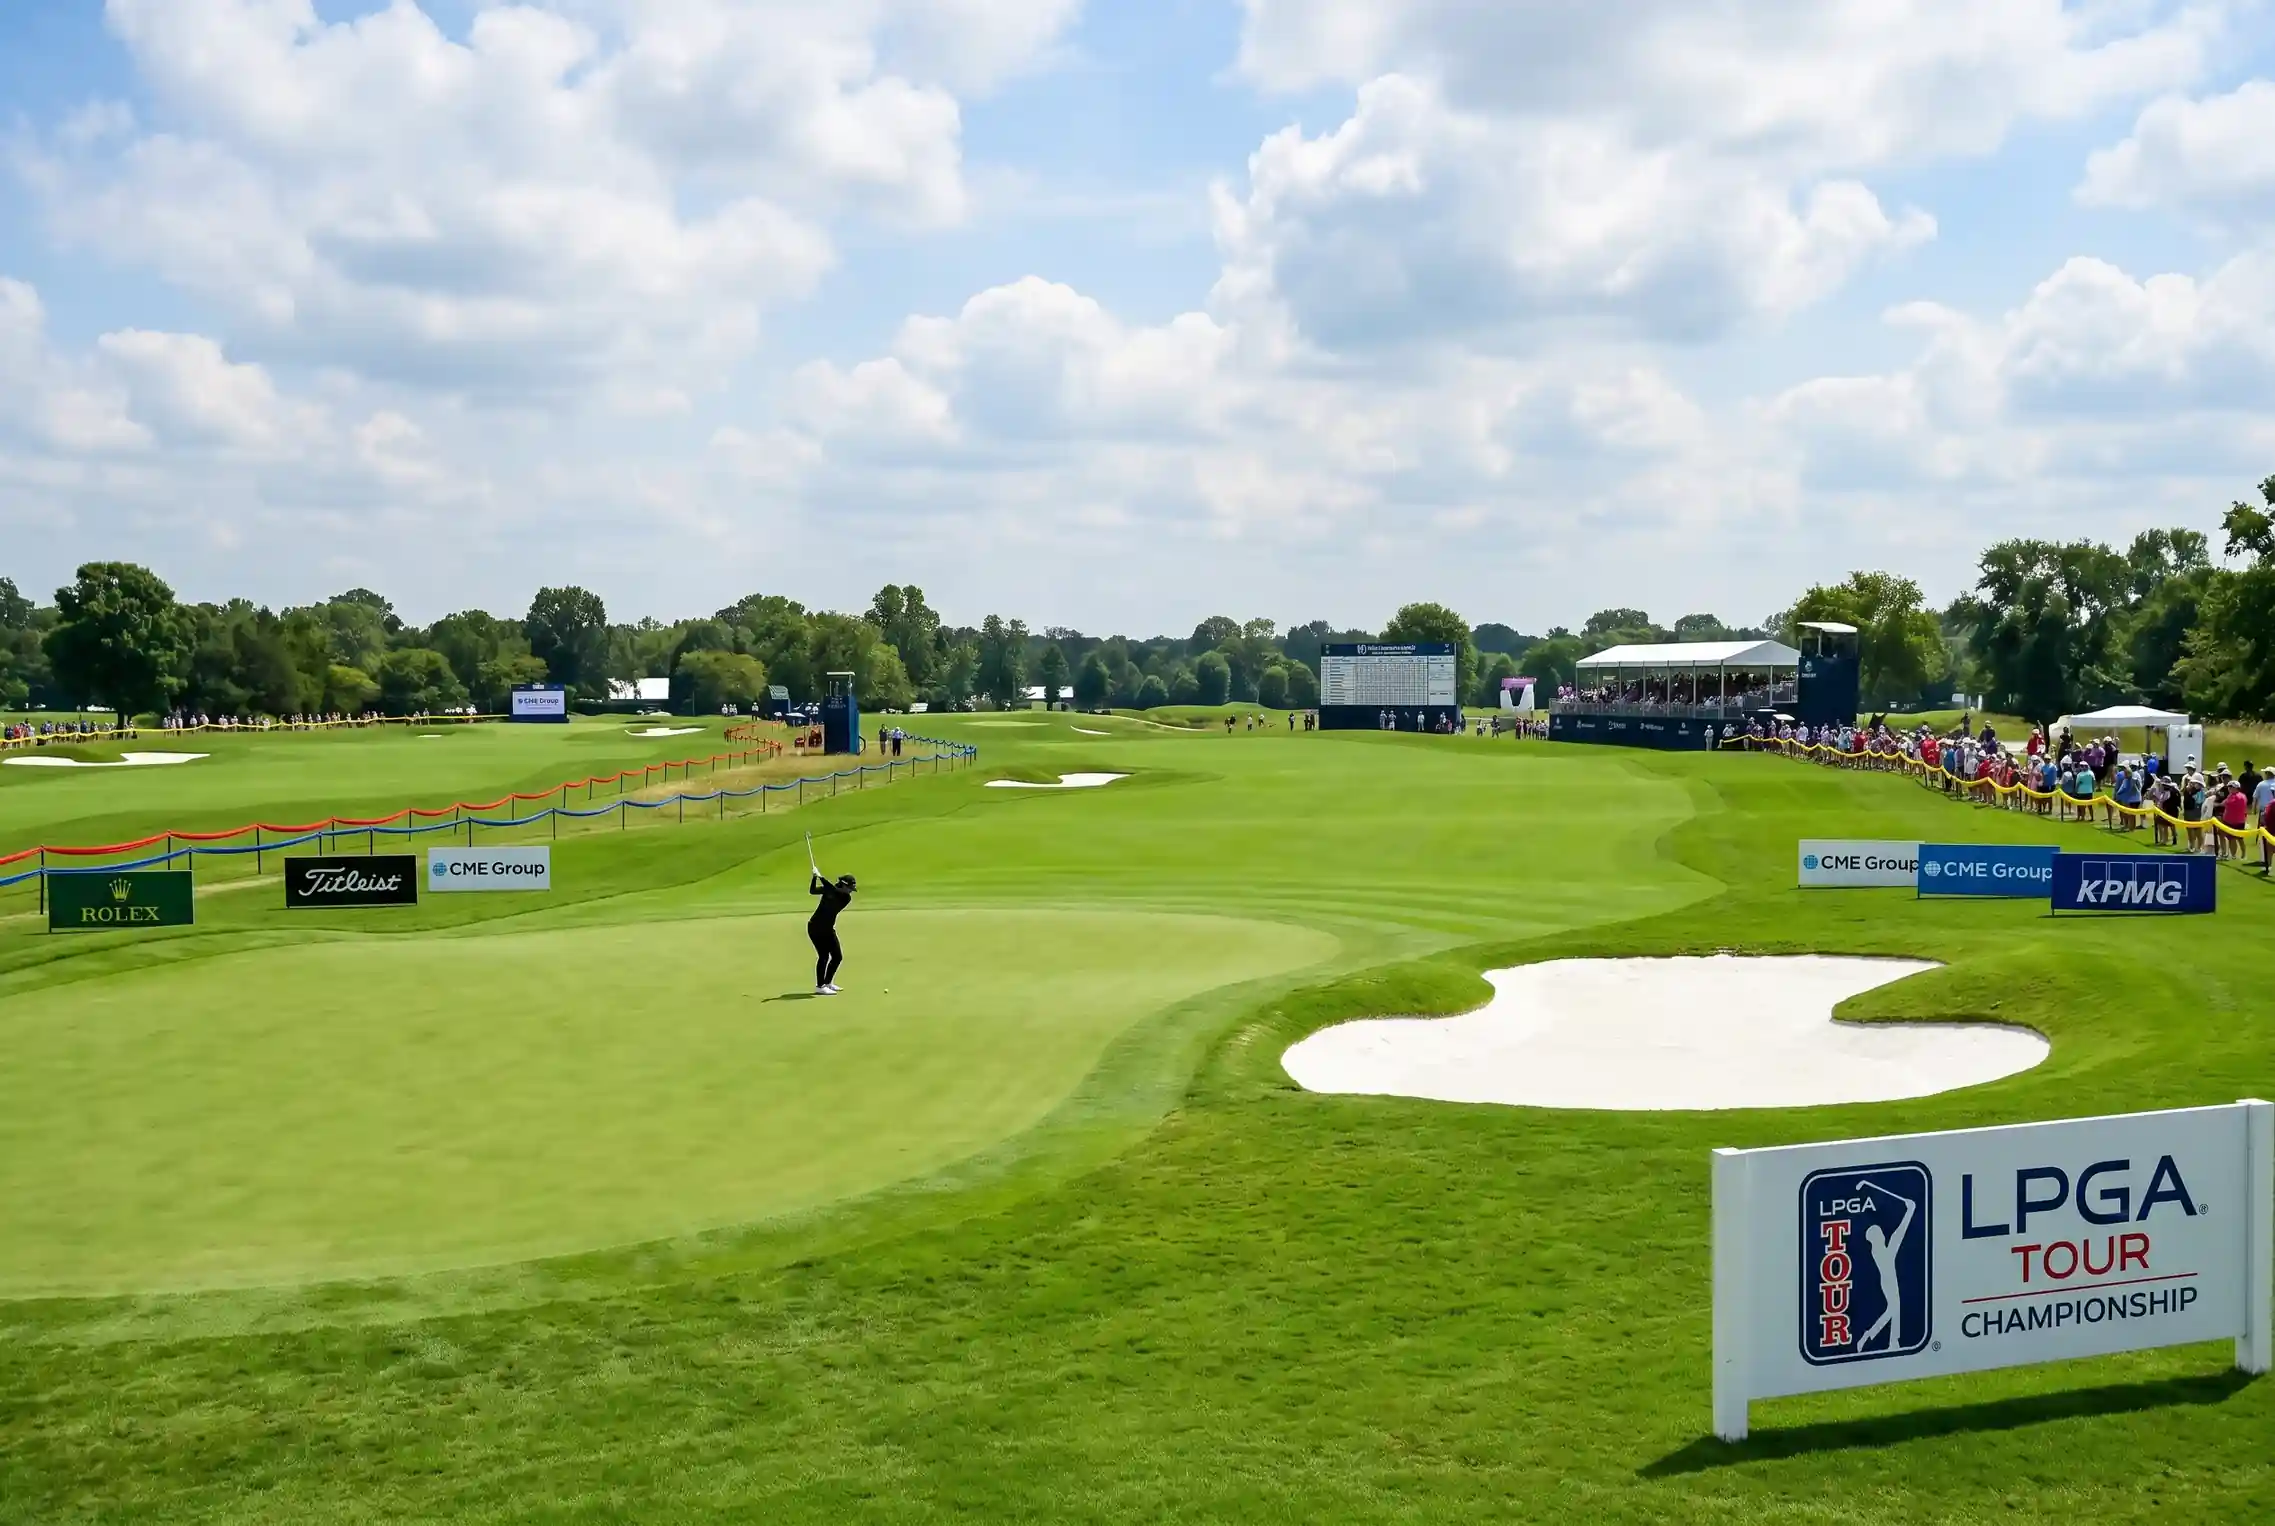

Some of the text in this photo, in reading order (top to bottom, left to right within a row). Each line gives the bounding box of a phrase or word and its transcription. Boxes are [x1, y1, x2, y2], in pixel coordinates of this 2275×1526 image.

[449, 861, 545, 879] CME Group
[1821, 855, 1919, 872] CME Group
[1944, 862, 2052, 882] CME Group
[298, 867, 401, 896] Titleist
[2076, 879, 2183, 905] KPMG
[81, 906, 160, 922] ROLEX
[1820, 1196, 1876, 1216] LPGA
[1962, 1154, 2198, 1240] LPGA
[2011, 1232, 2150, 1283] TOUR
[1820, 1219, 1852, 1348] TOUR
[1961, 1286, 2198, 1338] CHAMPIONSHIP
